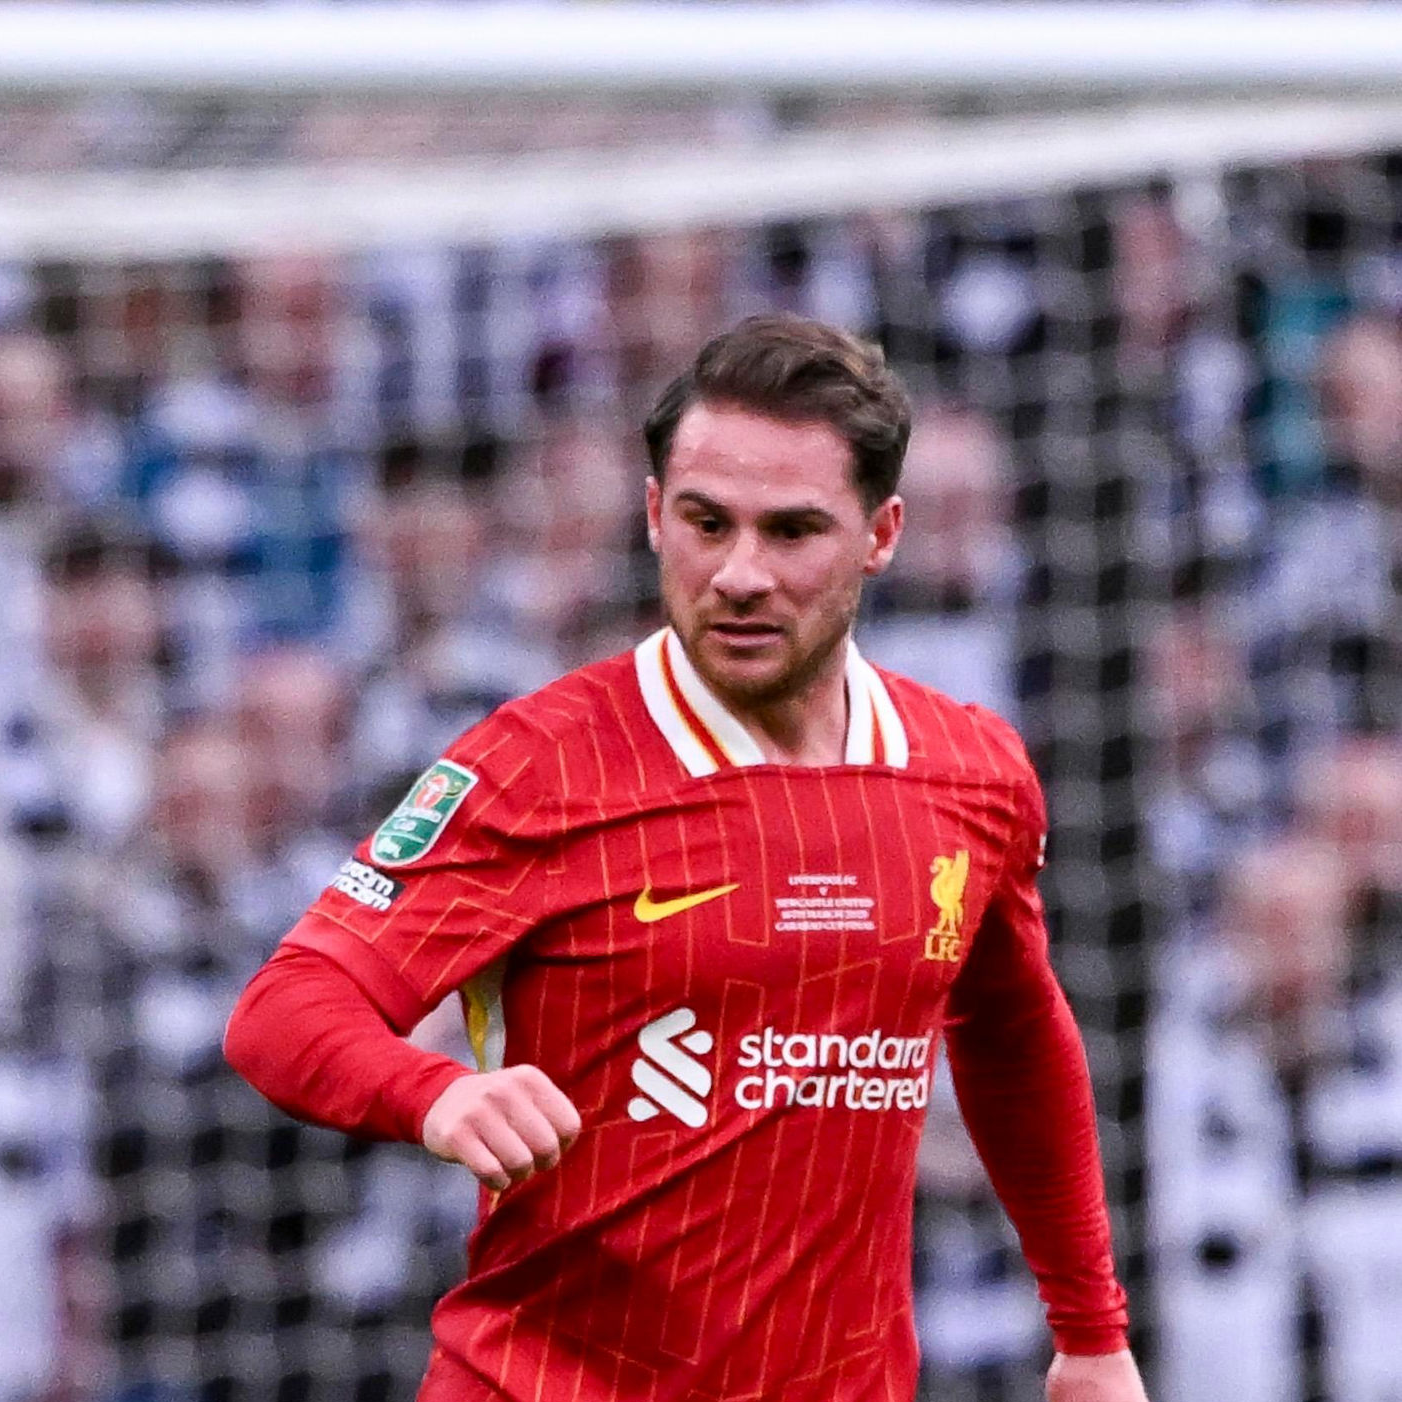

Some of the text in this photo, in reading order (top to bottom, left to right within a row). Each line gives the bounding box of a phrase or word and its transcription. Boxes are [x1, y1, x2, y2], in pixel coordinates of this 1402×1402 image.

[925, 935, 960, 962] LFC
[737, 1026, 931, 1070] standard
[735, 1070, 928, 1111] chartered
